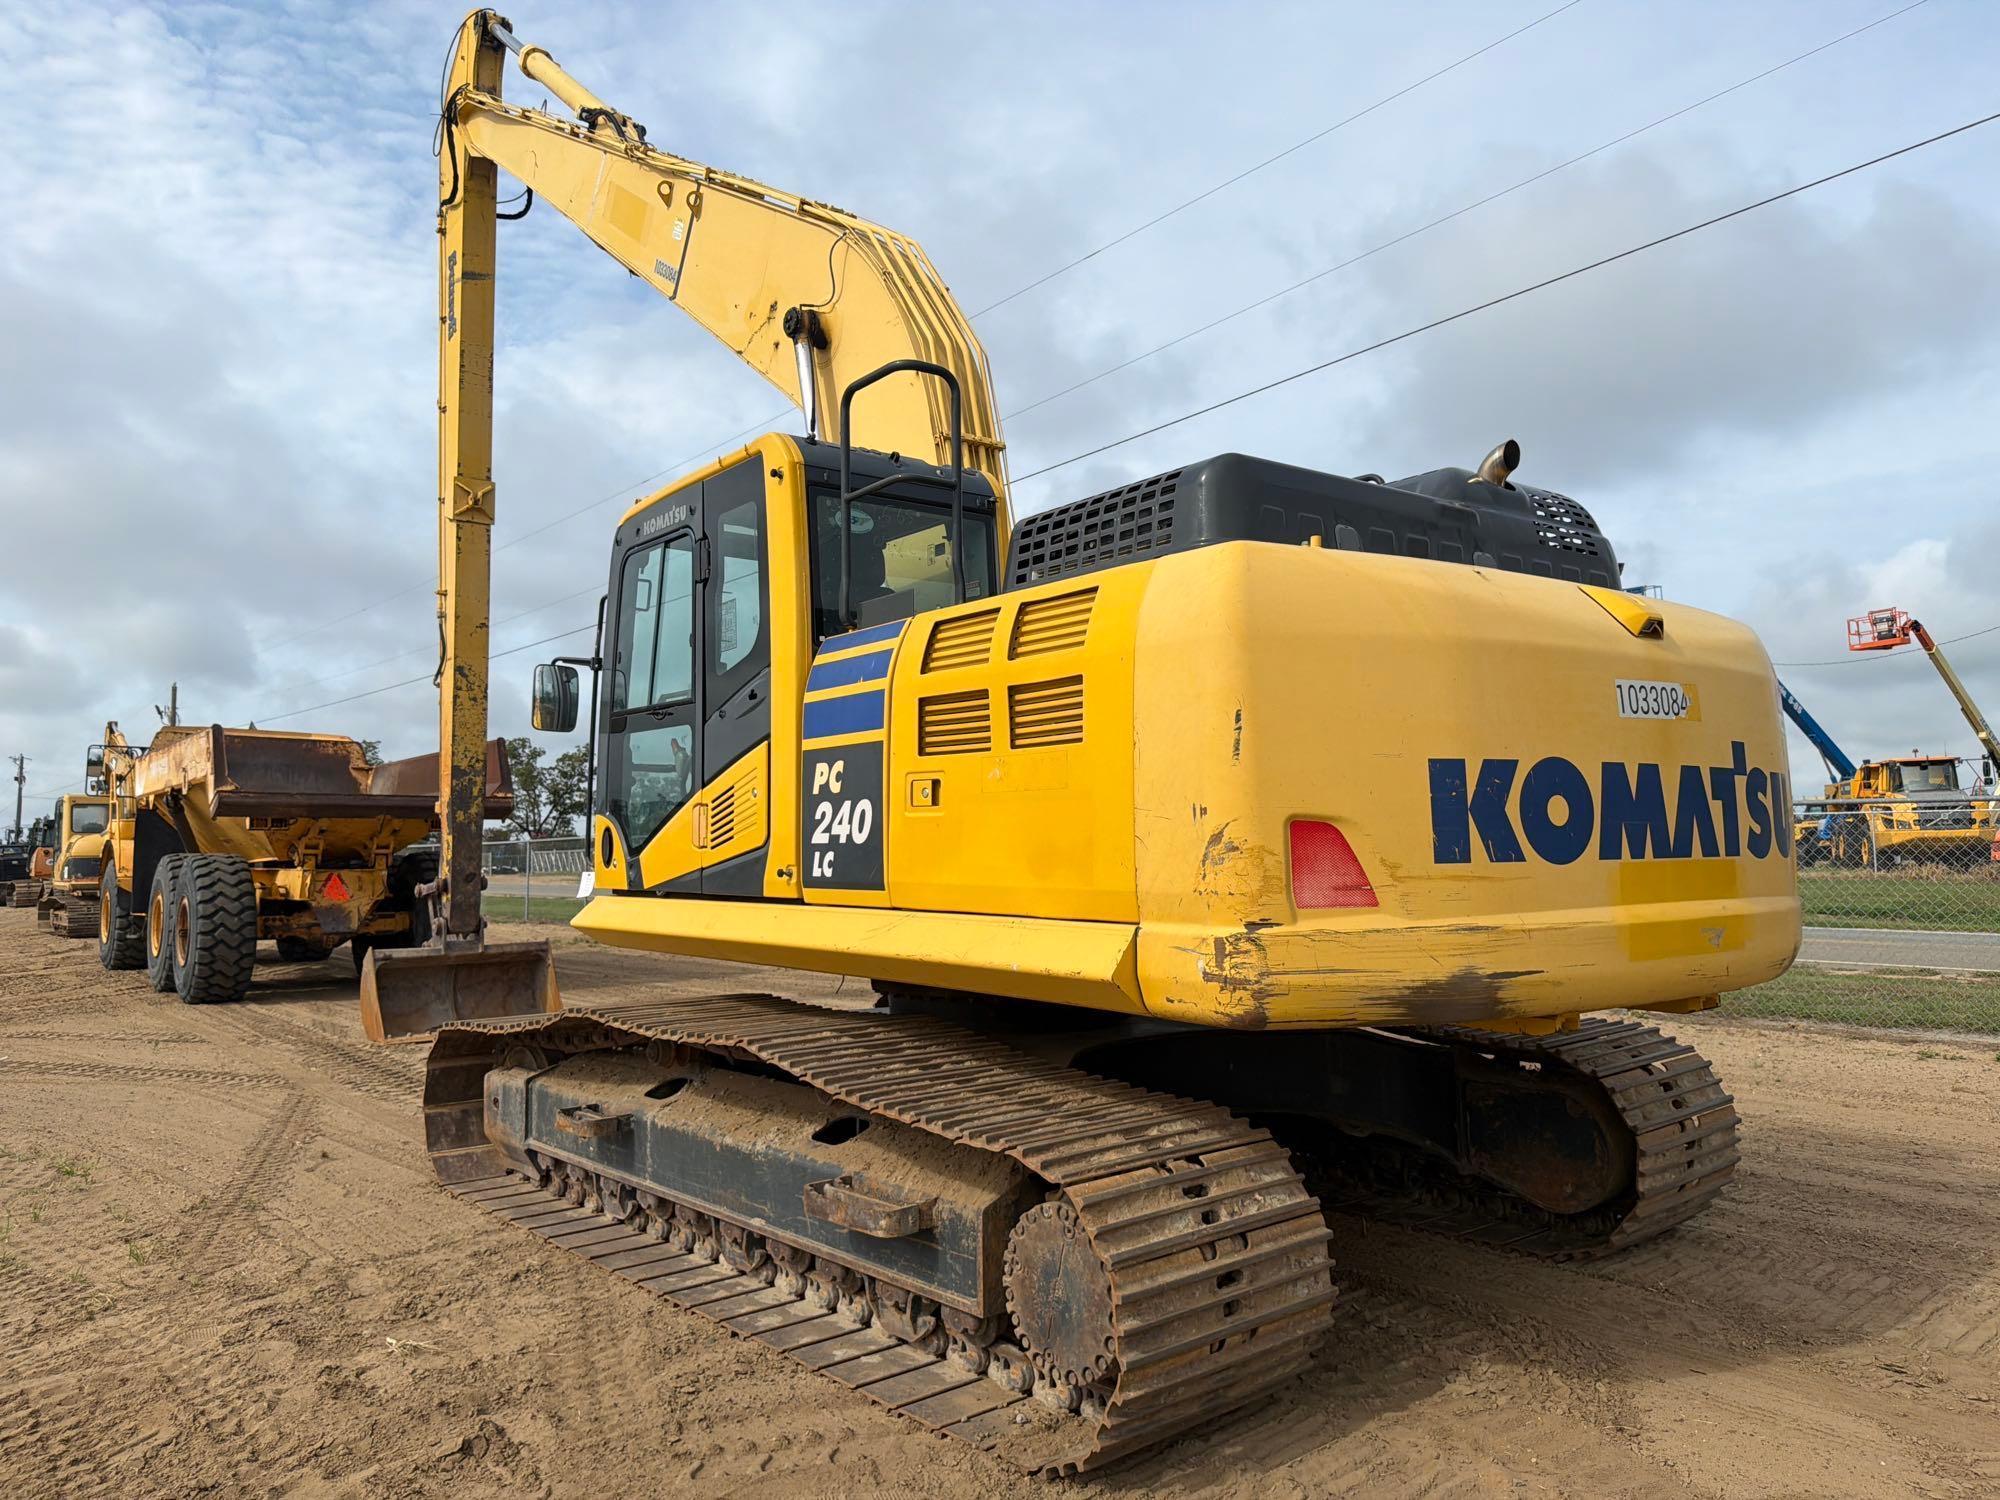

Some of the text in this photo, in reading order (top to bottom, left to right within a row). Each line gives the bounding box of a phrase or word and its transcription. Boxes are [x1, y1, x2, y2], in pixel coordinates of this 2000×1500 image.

[654, 258, 678, 285] 1033084
[643, 504, 687, 536] KOMATSU
[812, 760, 845, 795] PC
[1428, 740, 1791, 866] KOMATSU
[811, 798, 873, 845] 240
[812, 851, 835, 878] LC
